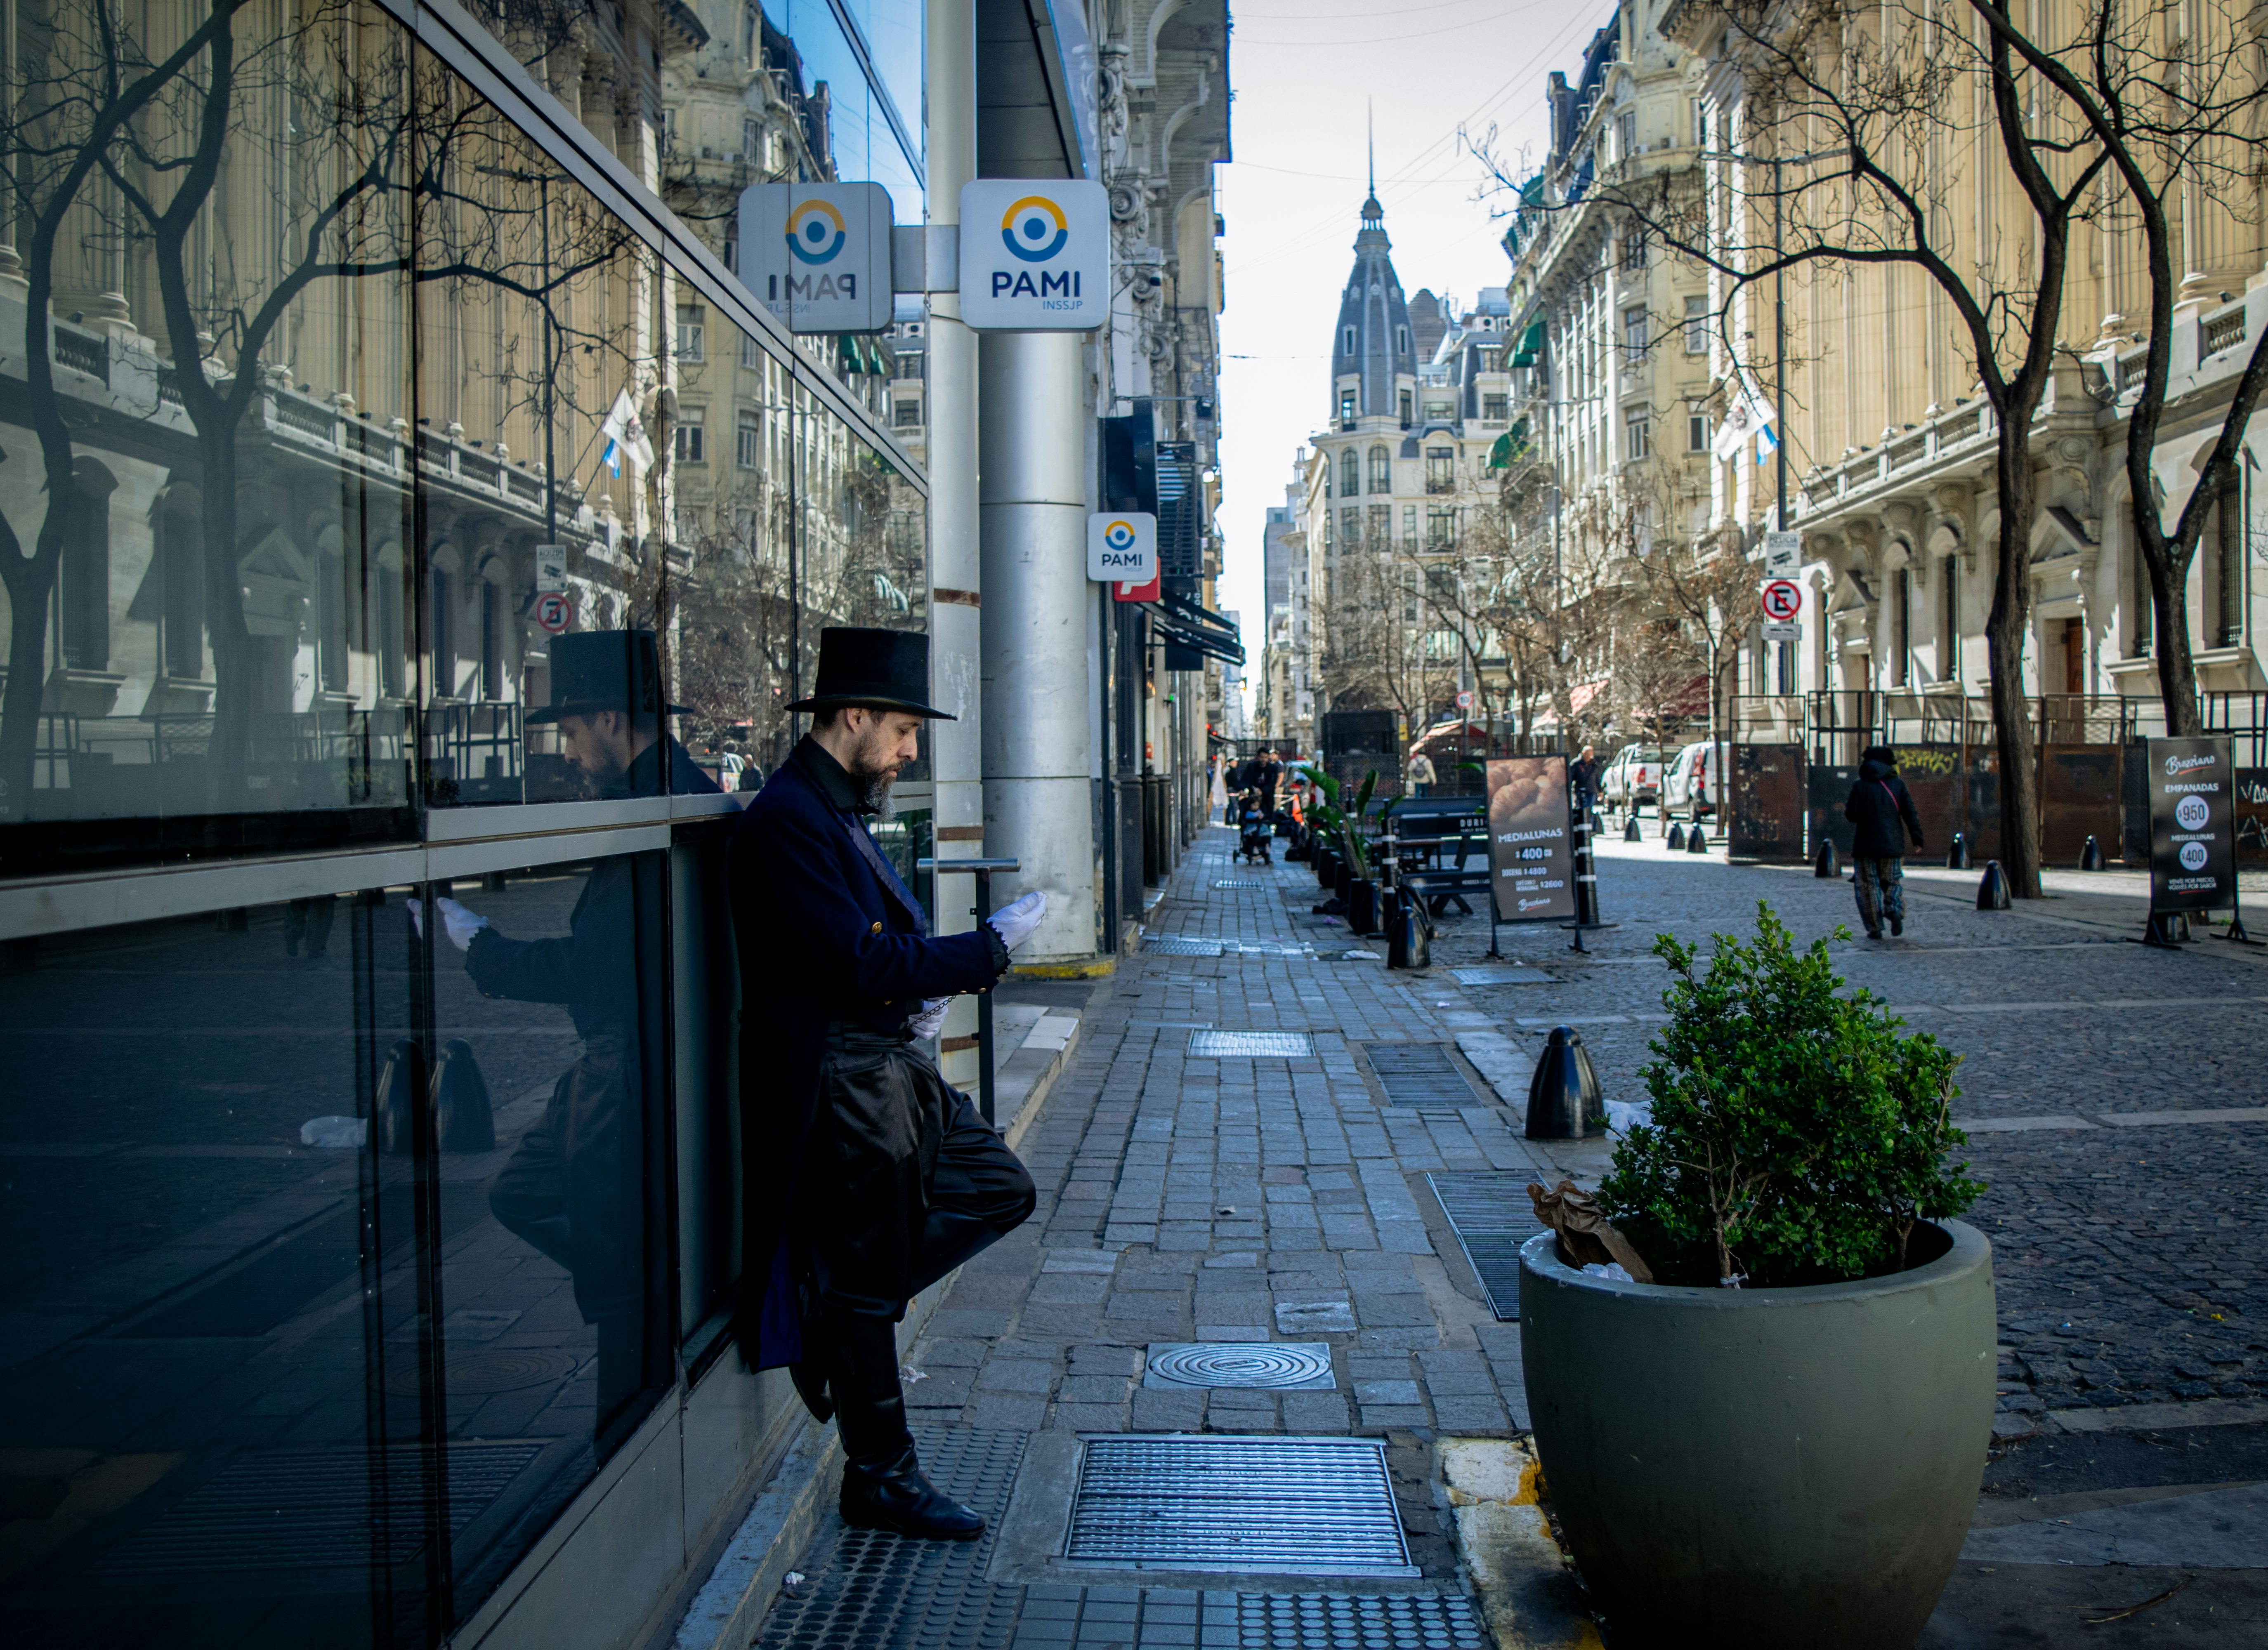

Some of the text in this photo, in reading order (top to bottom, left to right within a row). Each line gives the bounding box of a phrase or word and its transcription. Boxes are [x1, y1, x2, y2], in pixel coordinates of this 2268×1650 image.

[992, 271, 1080, 297] PAMI
[1043, 301, 1083, 309] INSSJP
[1101, 554, 1142, 566] PAMI
[2164, 783, 2219, 793] EMPANADAS
[1498, 827, 1563, 843] MEDIALUNAS
[1522, 847, 1543, 860] 400
[1502, 868, 1522, 877] DOCENA
